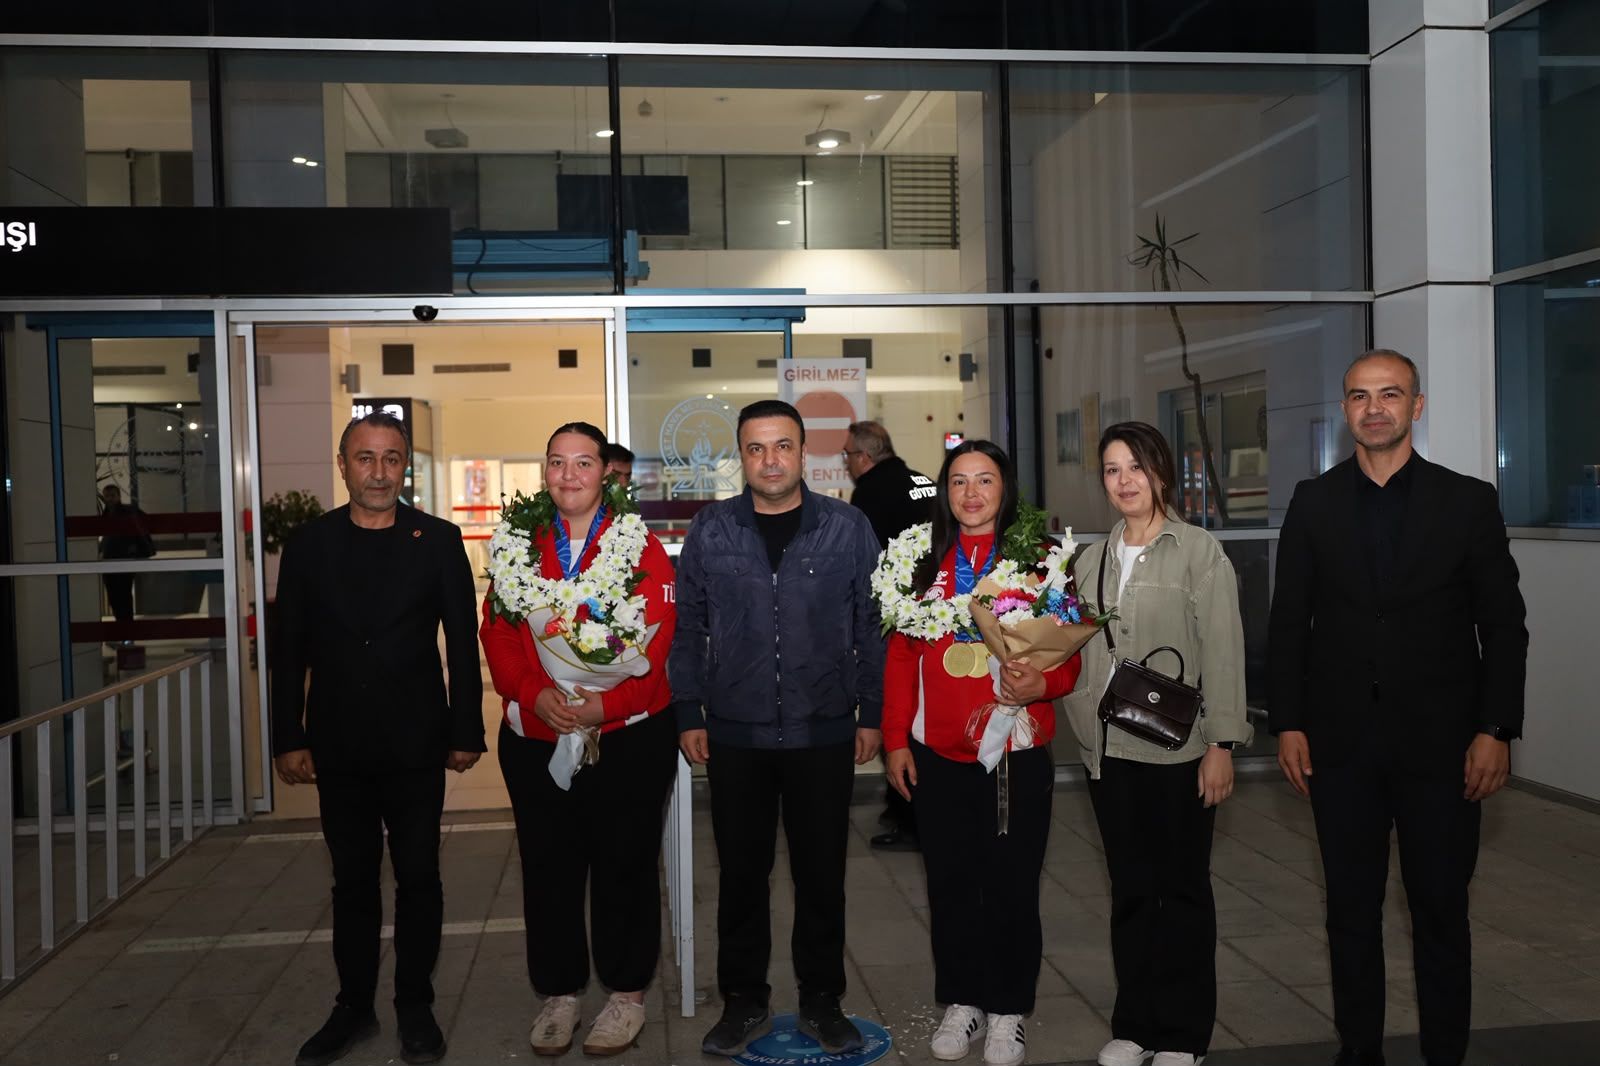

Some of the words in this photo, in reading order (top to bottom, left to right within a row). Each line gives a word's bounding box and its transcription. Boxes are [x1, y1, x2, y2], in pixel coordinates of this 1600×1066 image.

[784, 365, 861, 382] GİRİLMEZ
[812, 468, 850, 481] ENTR
[909, 486, 937, 501] GÜVEN
